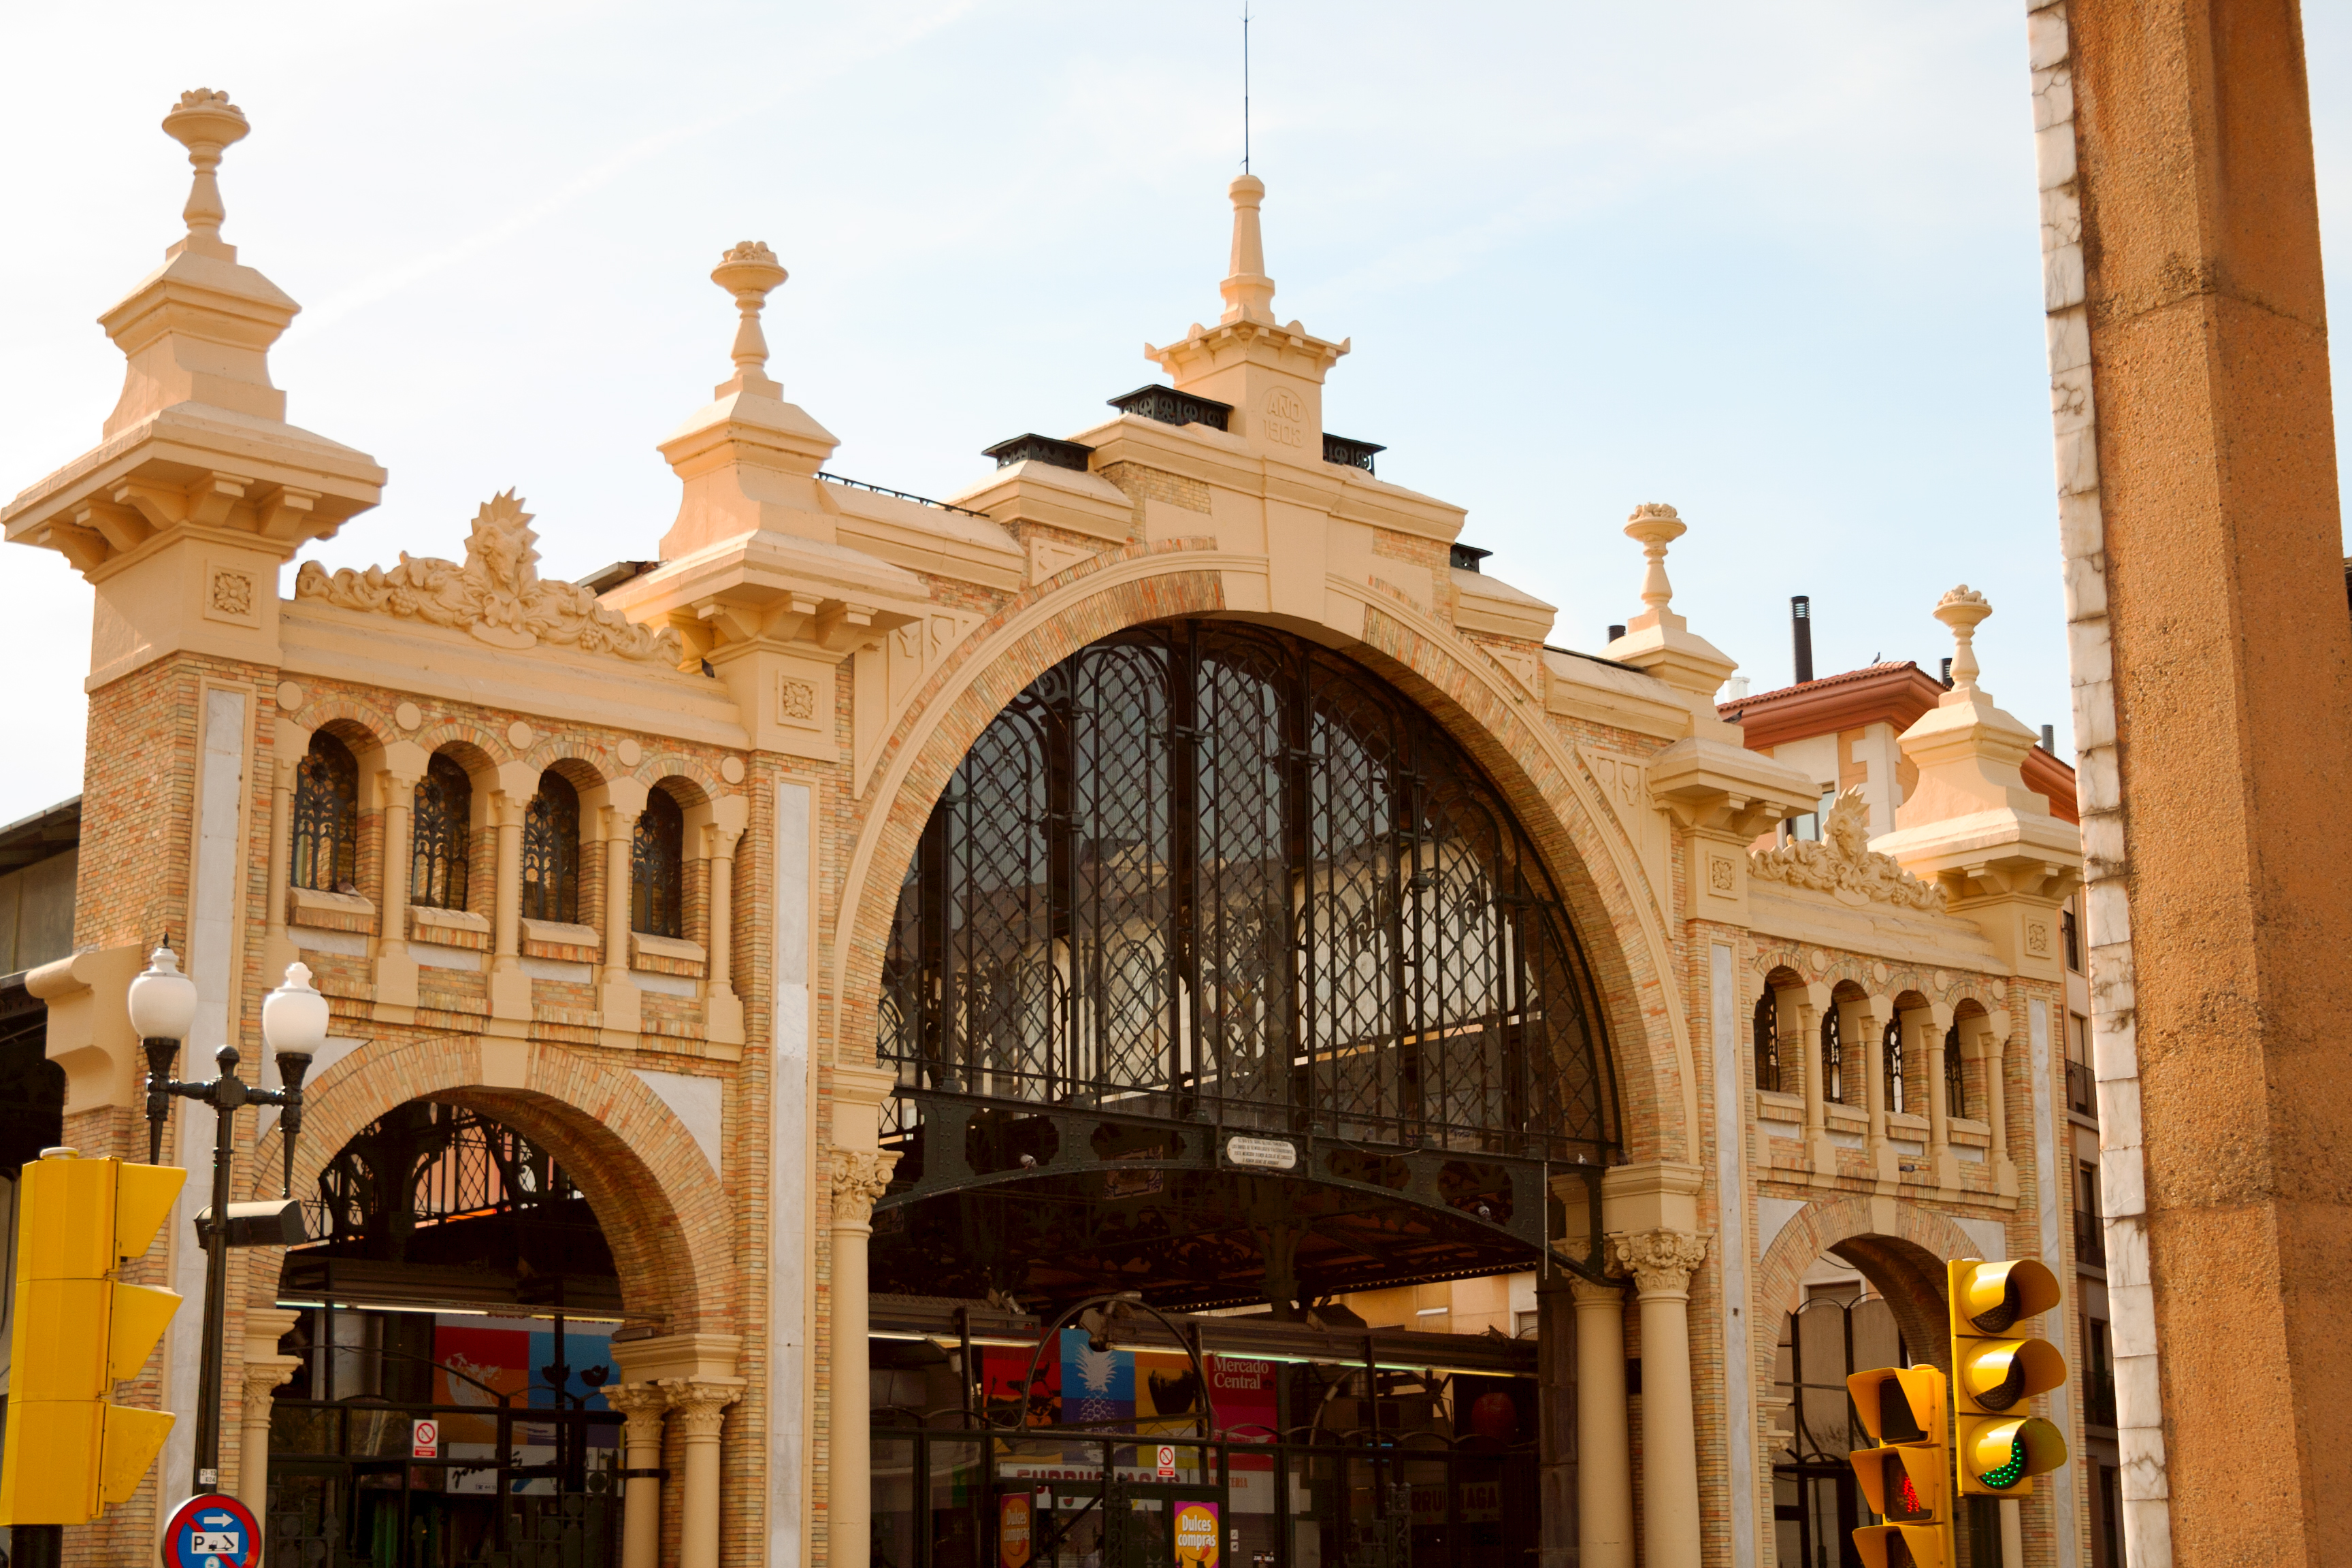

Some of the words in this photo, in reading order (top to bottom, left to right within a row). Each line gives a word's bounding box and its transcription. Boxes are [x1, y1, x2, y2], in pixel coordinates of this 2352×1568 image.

[1267, 393, 1301, 423] AÑO
[1263, 419, 1303, 448] 1903
[1213, 1356, 1269, 1374] Mercado
[1214, 1373, 1261, 1390] Central
[1007, 1507, 1027, 1526] Dulces
[1181, 1514, 1211, 1532] Dulces
[194, 1535, 205, 1551] P
[1004, 1528, 1030, 1546] compras
[1177, 1533, 1216, 1551] compras
